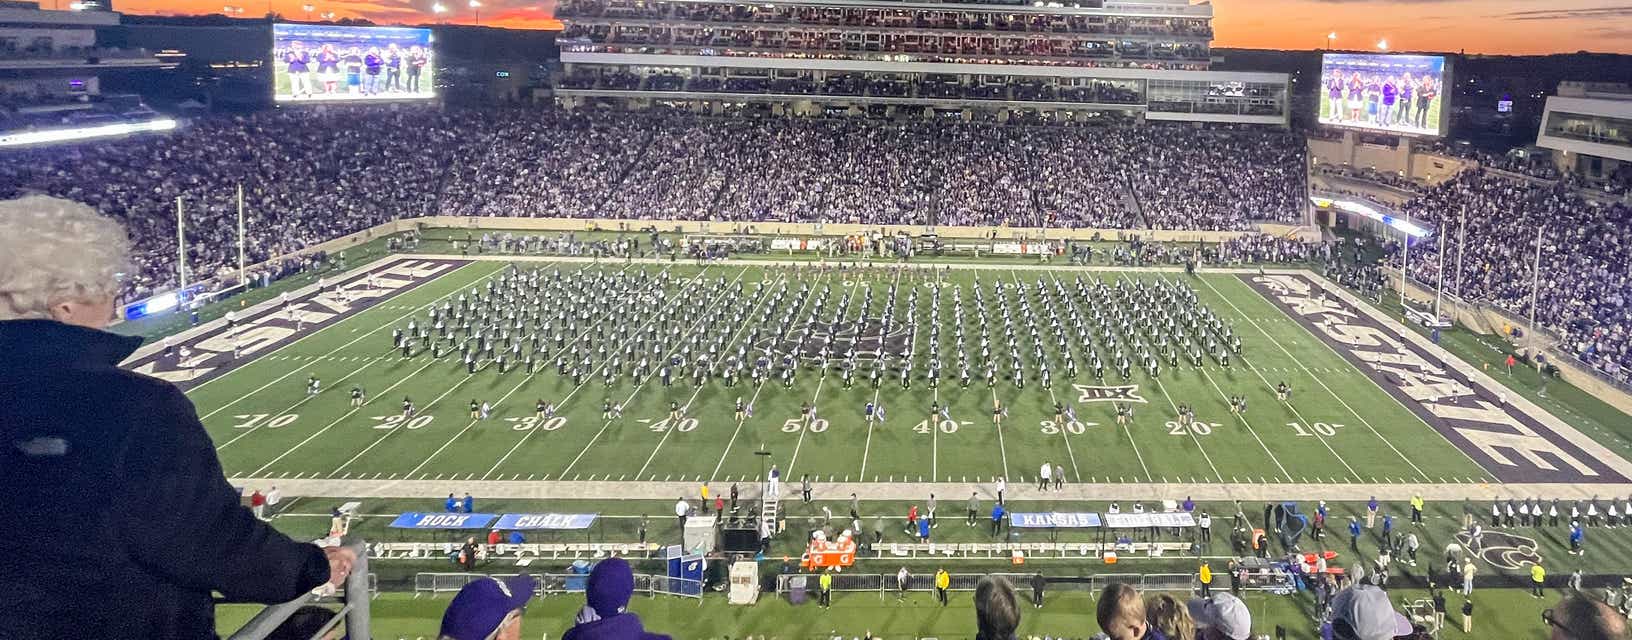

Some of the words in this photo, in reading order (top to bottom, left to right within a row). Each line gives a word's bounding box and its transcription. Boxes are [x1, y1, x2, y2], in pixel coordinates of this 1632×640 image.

[234, 413, 299, 429] 10
[373, 414, 435, 430] 20
[512, 416, 567, 431] 30
[649, 417, 699, 432] 40
[781, 417, 829, 432] 50
[912, 419, 959, 434] 40
[1039, 419, 1086, 434] 30
[1165, 421, 1212, 435] 20
[1286, 421, 1337, 437] 10
[416, 514, 470, 527] ROCK
[515, 513, 573, 527] CHALK
[1023, 513, 1089, 526] KANSAS
